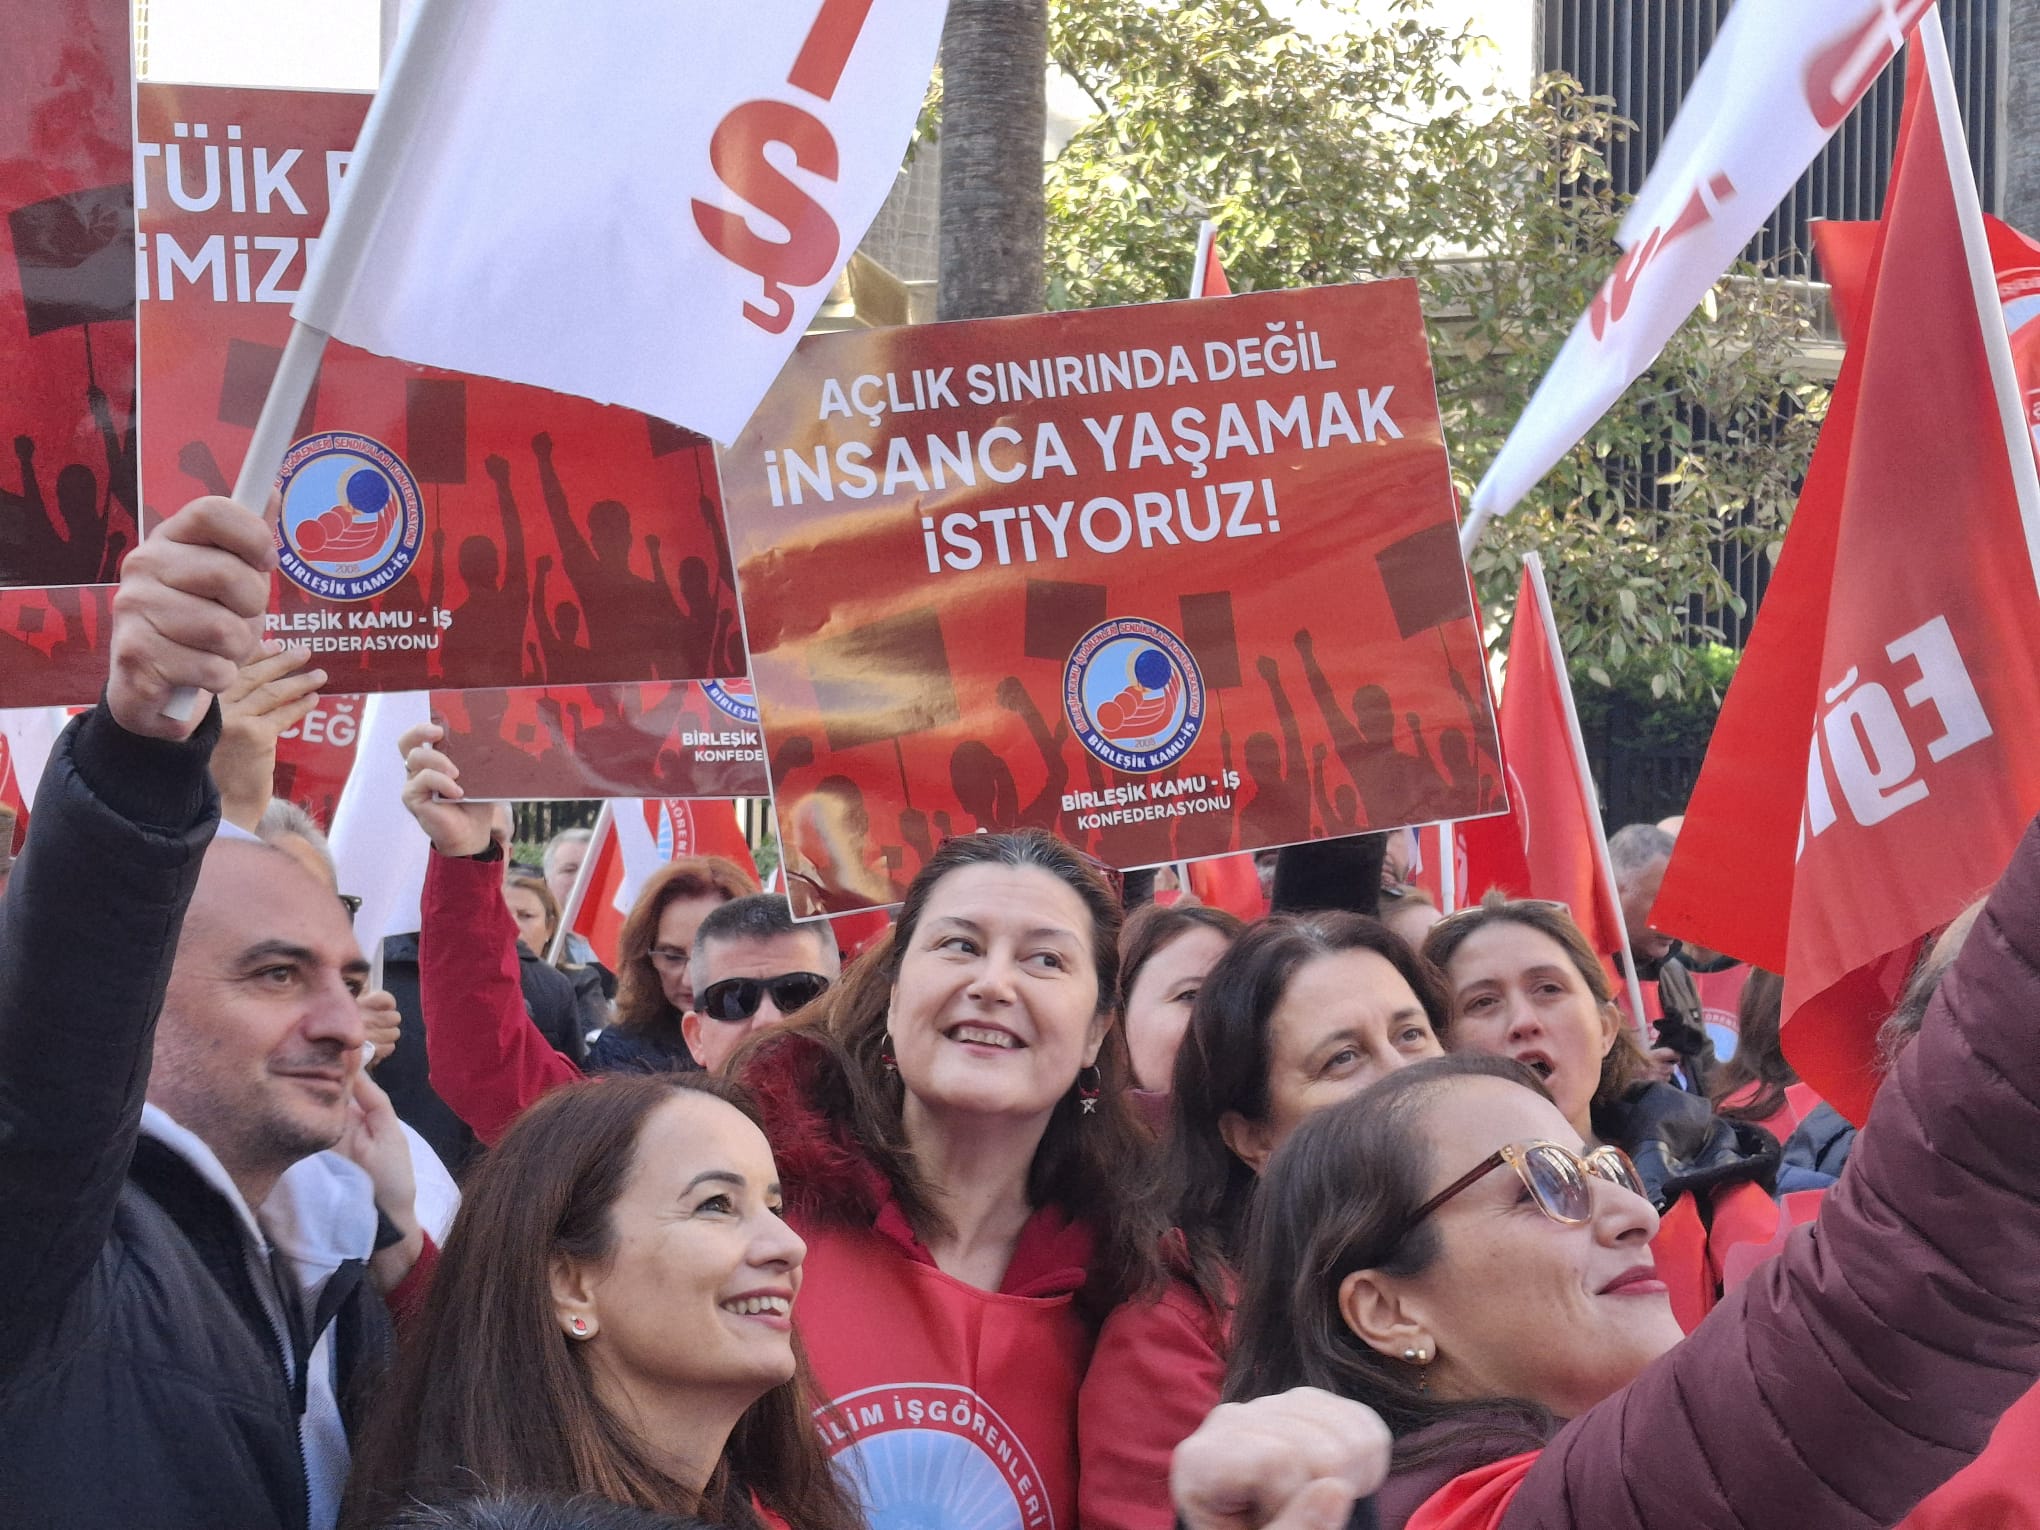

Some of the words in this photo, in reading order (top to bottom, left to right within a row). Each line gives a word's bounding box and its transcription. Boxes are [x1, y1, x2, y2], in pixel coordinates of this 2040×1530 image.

[137, 122, 308, 215] TÜİK
[819, 367, 960, 427] AÇLIK
[966, 346, 1199, 405] SINIRINDA
[1204, 320, 1337, 381] DEĞİL
[764, 422, 1078, 507] İNSANCA
[1083, 385, 1405, 479] YAŞAMAK
[921, 478, 1281, 573] İSTİYORUZ!
[280, 552, 346, 596] BİRLEŞİK
[351, 551, 410, 595] KAMU-İŞ
[264, 609, 344, 633] RLEŞİK
[349, 610, 413, 629] KAMU
[432, 606, 453, 630] İŞ
[682, 729, 758, 748] BİRLEŞİK
[694, 749, 764, 762] KONFEDE
[1087, 733, 1148, 769] BİRLEŞİK
[1150, 720, 1197, 768] KAMU-İŞ
[1061, 782, 1148, 812] BİRLEŞİK
[1151, 774, 1207, 800] KAMU
[1222, 768, 1241, 790] İŞ
[1077, 794, 1232, 830] KONFEDERASYONU
[815, 1403, 884, 1446] İLİM
[893, 1395, 1045, 1528] İŞGÖRENLERİ
